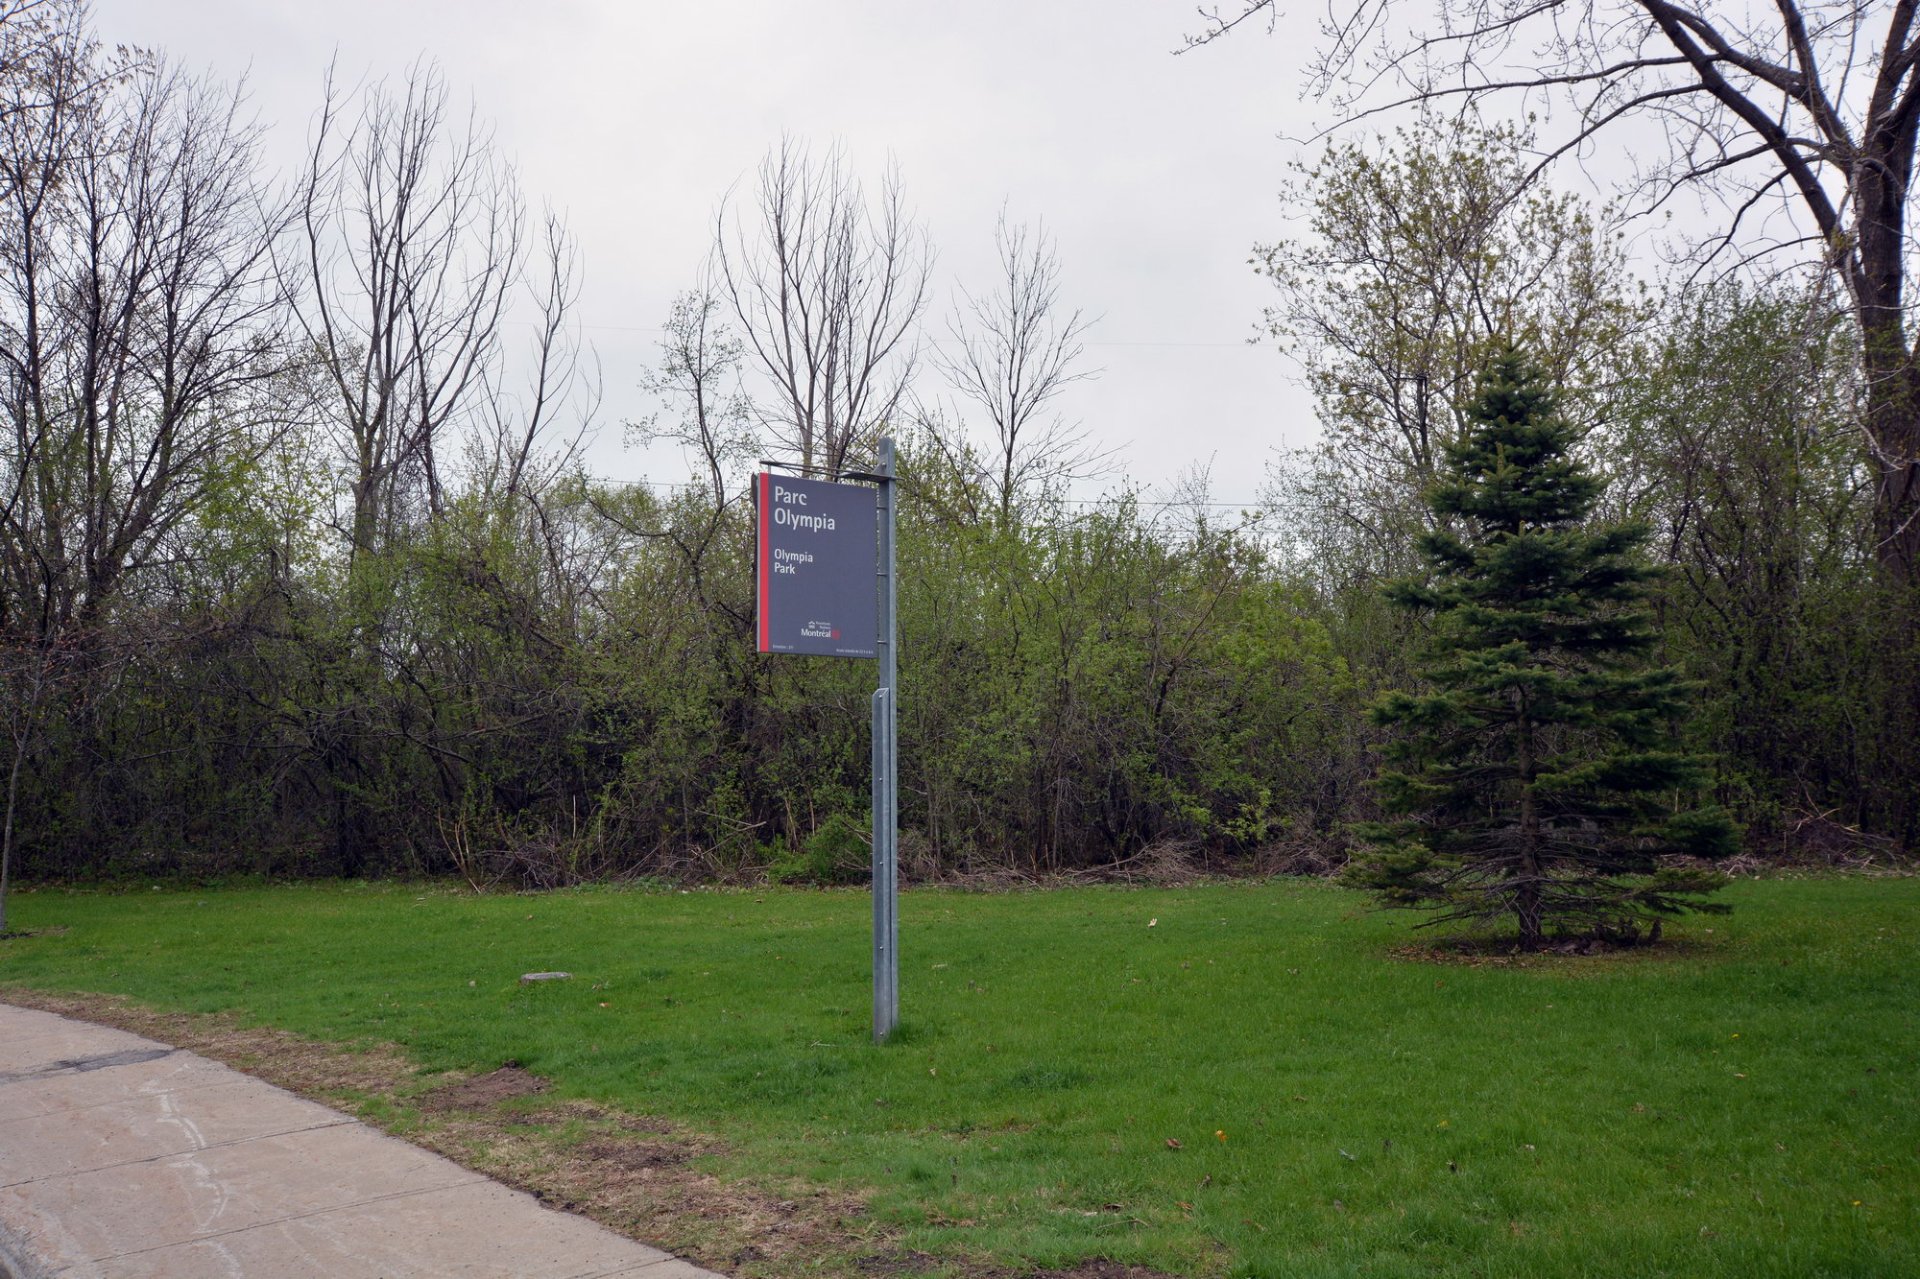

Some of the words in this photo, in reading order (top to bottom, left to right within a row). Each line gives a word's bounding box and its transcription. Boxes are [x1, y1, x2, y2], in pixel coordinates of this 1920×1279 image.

[774, 485, 808, 506] Parc
[774, 507, 836, 533] Olympia
[774, 548, 814, 564] Olympia
[774, 562, 796, 575] Park
[800, 628, 832, 638] Montréal
